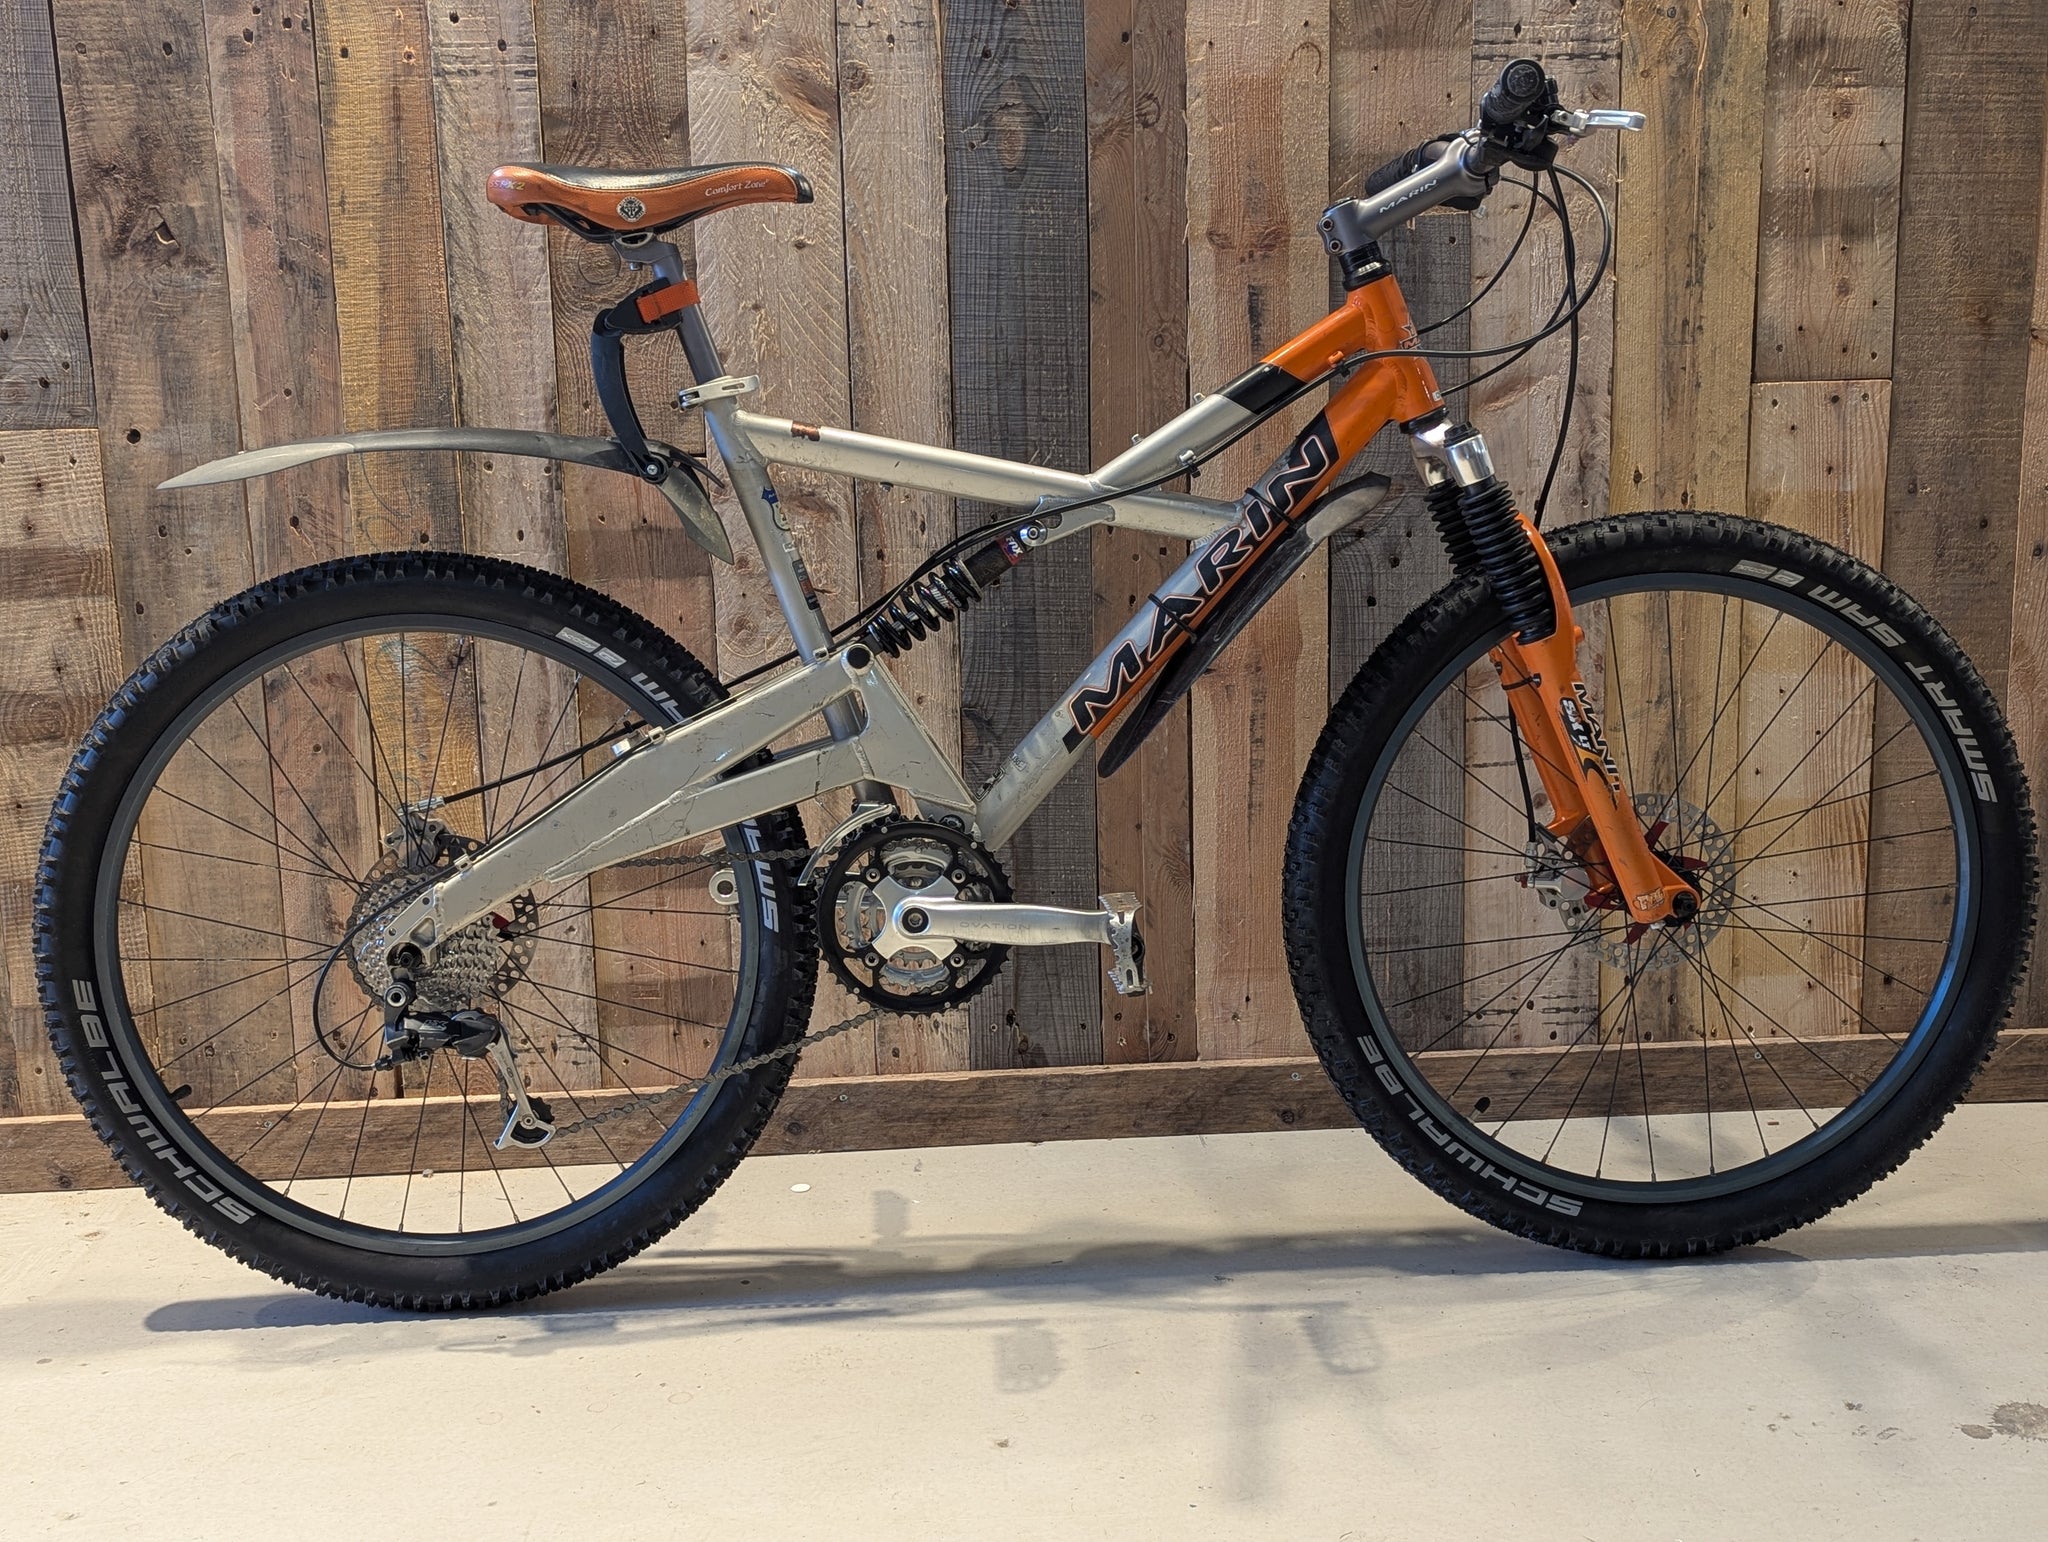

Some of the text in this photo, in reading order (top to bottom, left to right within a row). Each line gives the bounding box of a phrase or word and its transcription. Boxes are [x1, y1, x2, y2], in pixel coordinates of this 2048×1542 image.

[704, 180, 766, 197] Comfort Zone
[1379, 178, 1437, 214] MARIN
[1067, 434, 1331, 735] MARIN
[1806, 584, 1907, 648] SAM
[1903, 660, 1999, 804] SMART
[959, 921, 1031, 930] OVATION
[71, 979, 257, 1225] SCHWALBE
[1356, 1034, 1584, 1217] SCHWALBE
